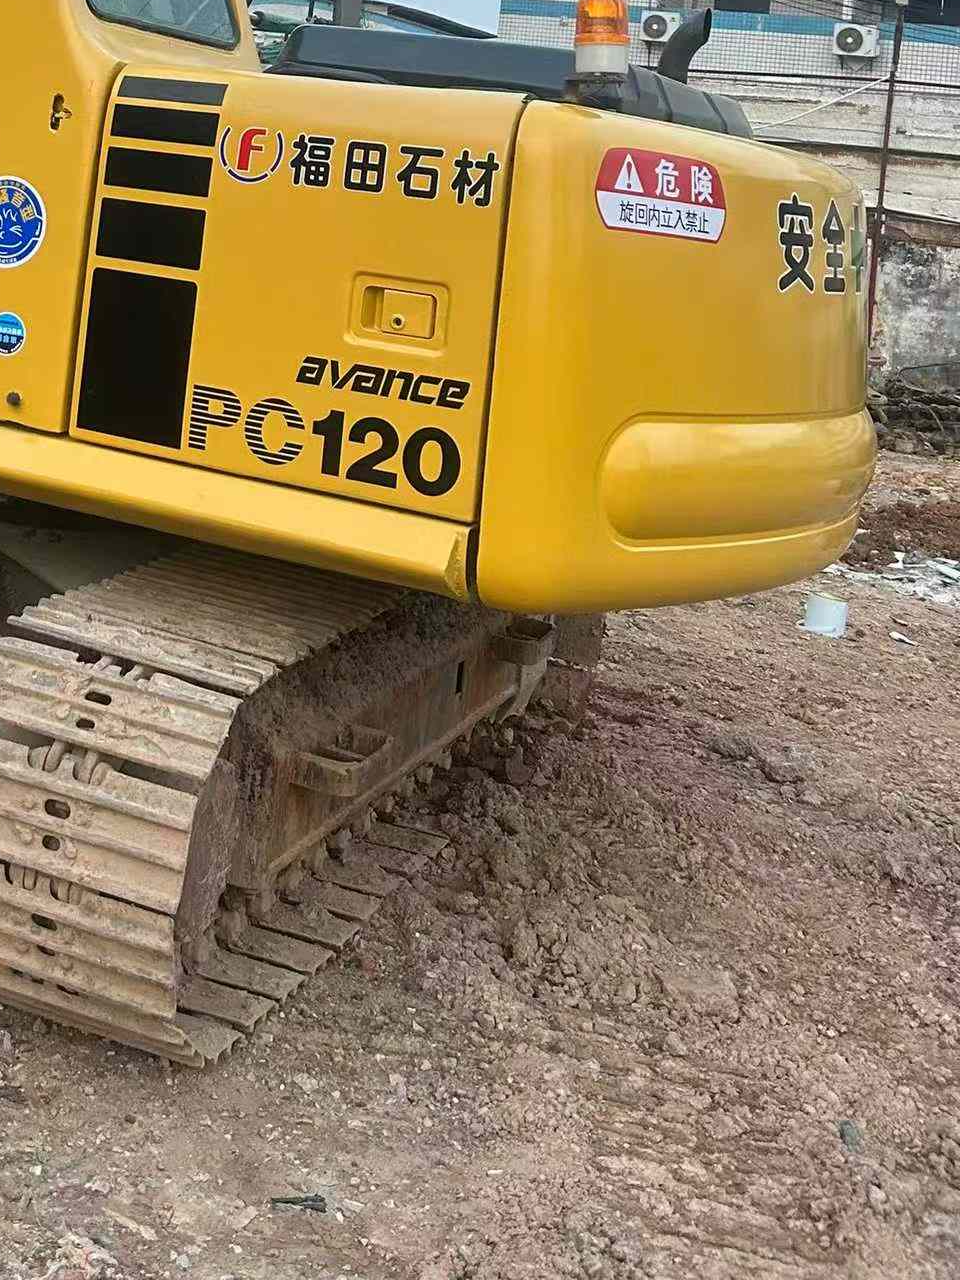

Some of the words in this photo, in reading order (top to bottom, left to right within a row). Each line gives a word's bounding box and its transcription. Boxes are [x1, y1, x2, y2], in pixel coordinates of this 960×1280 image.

[291, 135, 499, 207] 福田石材
[655, 159, 714, 204] 危険
[619, 199, 710, 234] 旋回内立入禁止
[295, 355, 471, 410] avance
[188, 384, 461, 497] PC120
